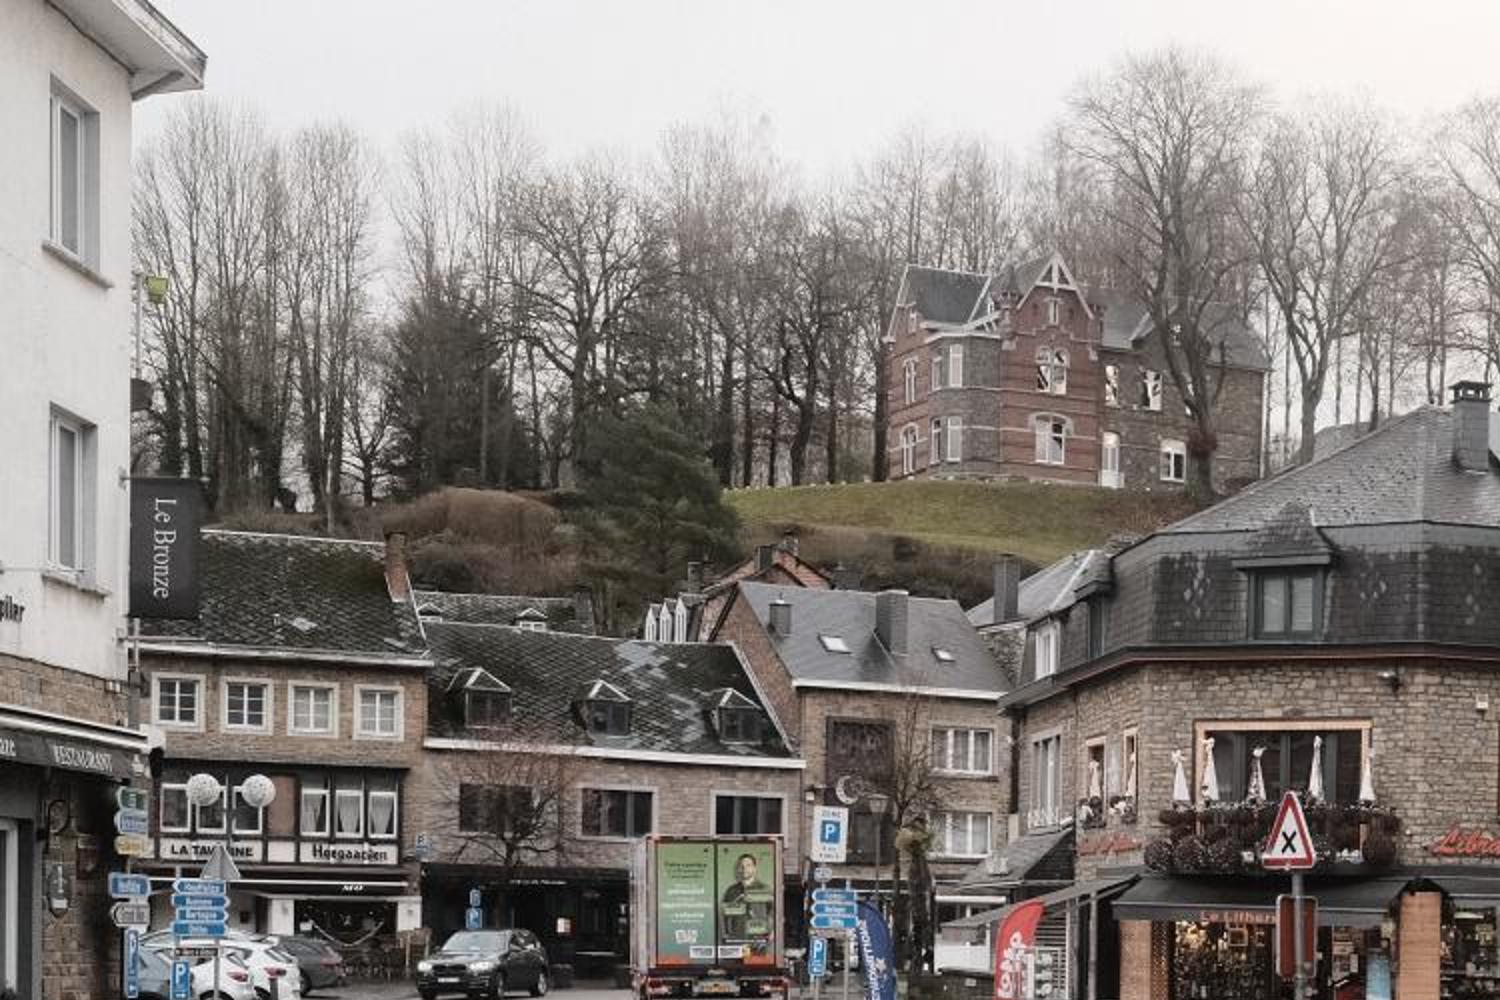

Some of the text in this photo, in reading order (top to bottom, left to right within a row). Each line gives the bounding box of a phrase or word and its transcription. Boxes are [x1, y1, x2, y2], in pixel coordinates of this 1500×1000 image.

[153, 498, 177, 599] Le Bronze
[171, 844, 189, 855] LA
